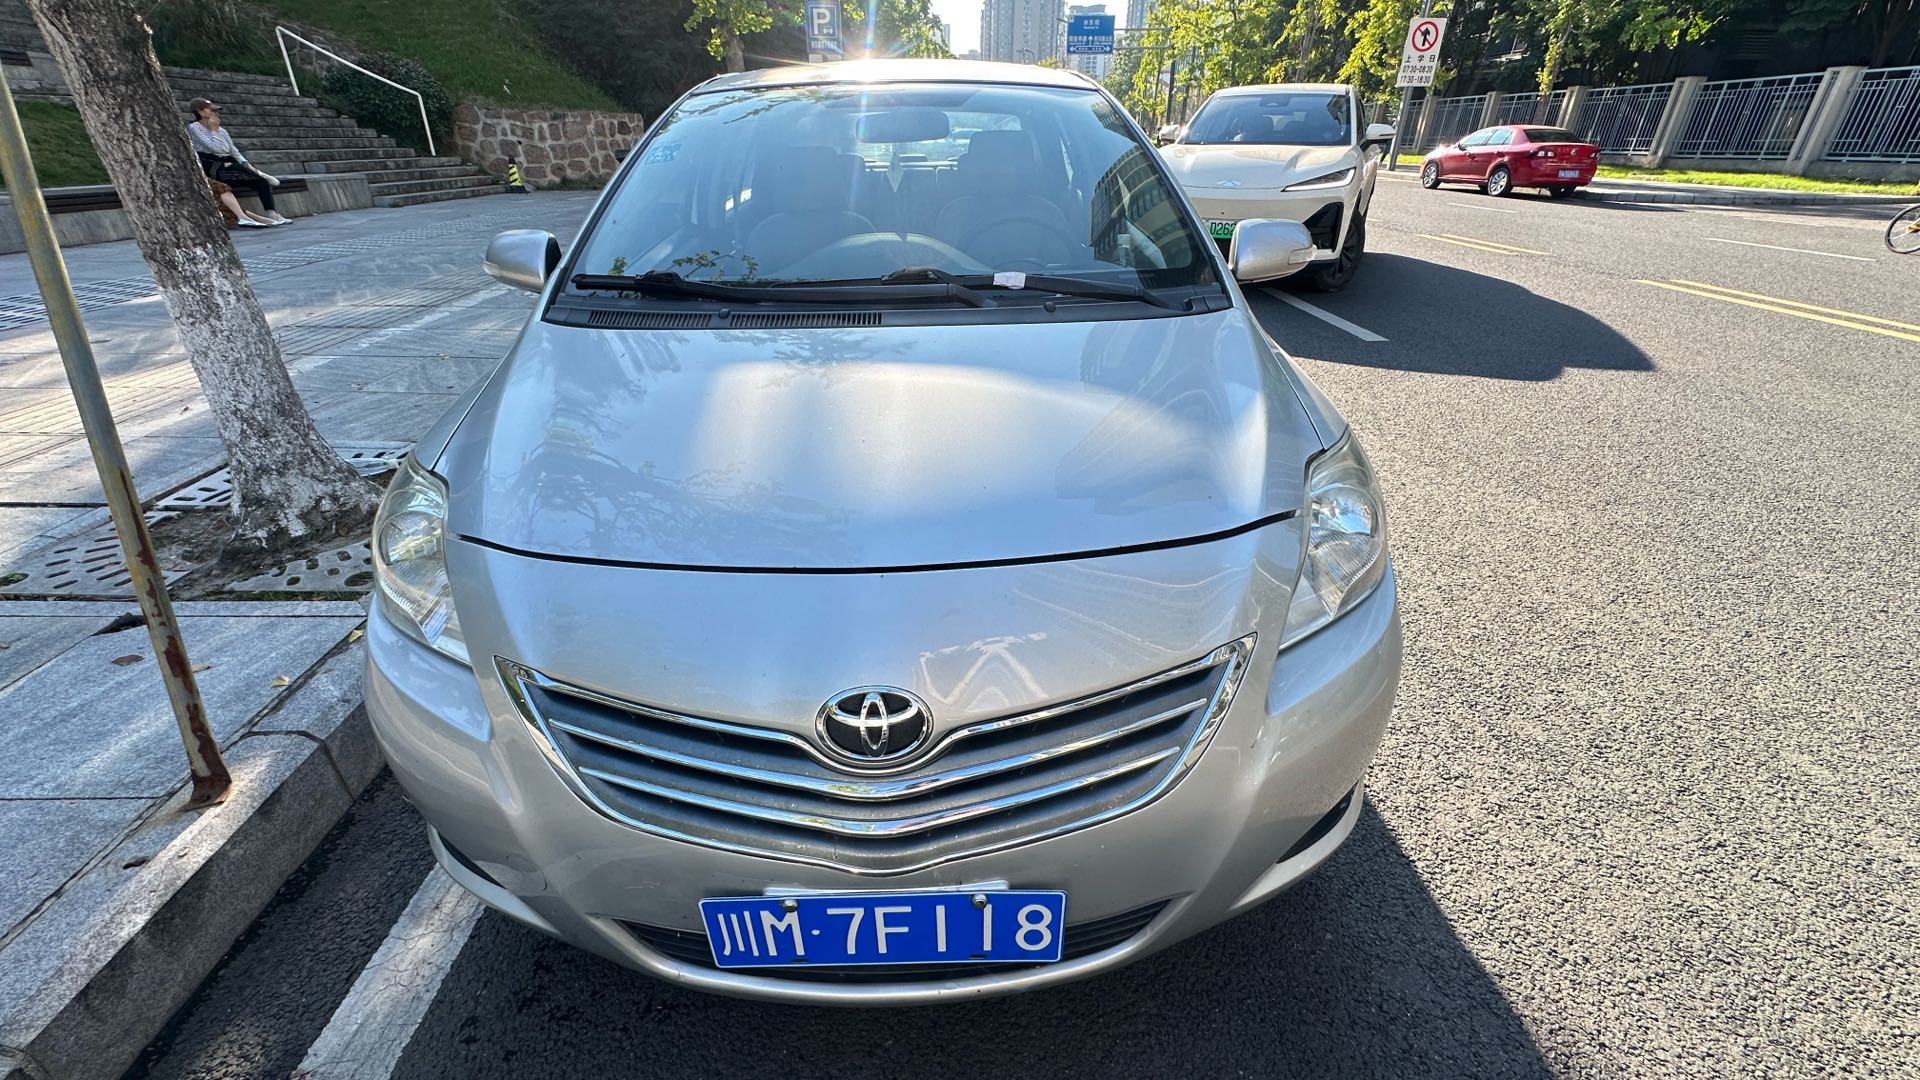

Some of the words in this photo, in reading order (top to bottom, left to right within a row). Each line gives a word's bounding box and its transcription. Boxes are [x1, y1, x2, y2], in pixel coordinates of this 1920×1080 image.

[812, 8, 831, 35] P
[1404, 54, 1436, 63] 上学日
